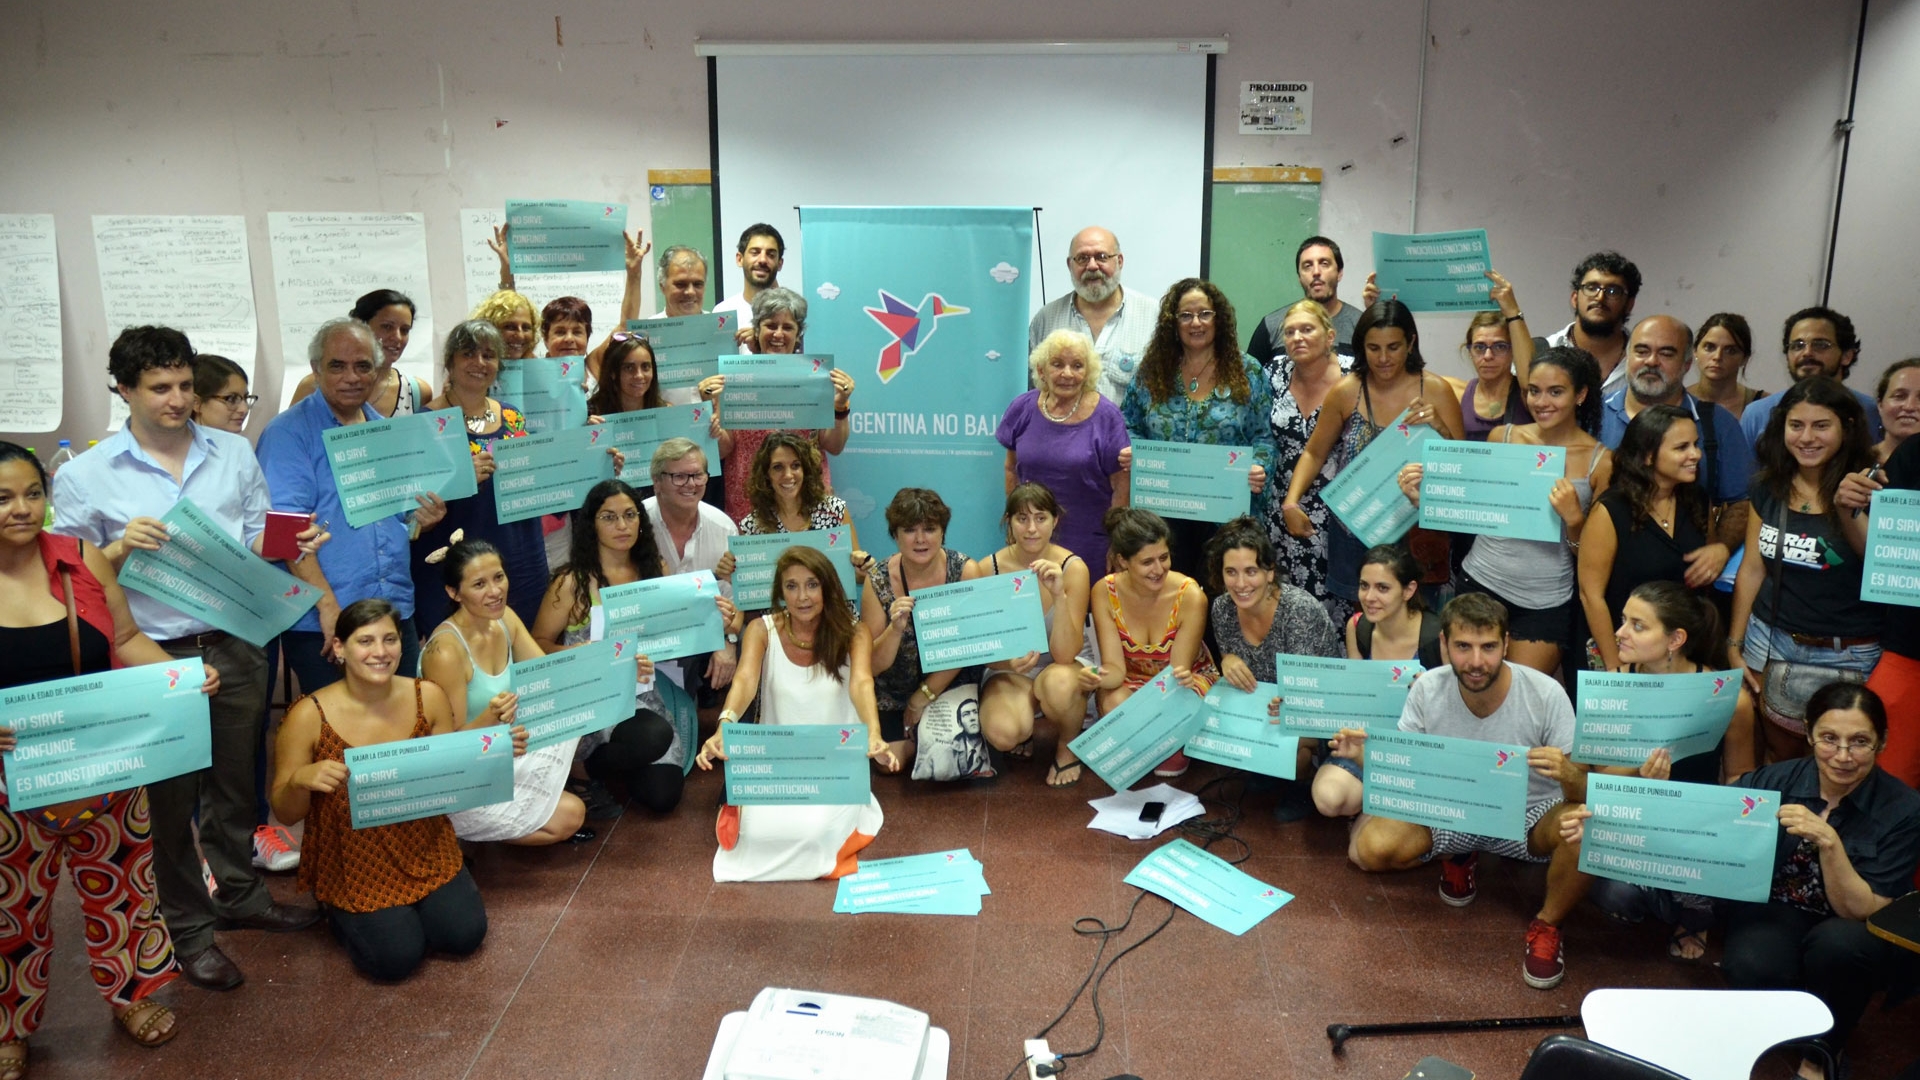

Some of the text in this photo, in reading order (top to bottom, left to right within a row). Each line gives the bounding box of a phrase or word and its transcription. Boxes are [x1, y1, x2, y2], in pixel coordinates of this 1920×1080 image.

[512, 216, 542, 224] NO SIRVE
[513, 234, 547, 243] CONFUNDE
[1405, 241, 1482, 255] ES INCONSTITUCIONAL
[514, 253, 585, 262] ES INCONSTITUCIONAL
[1448, 262, 1485, 274] CONFUNDE
[1456, 284, 1476, 293] SIRVE
[724, 392, 757, 401] CONFUNDE
[734, 410, 794, 419] INCONSTITUCIONAL
[852, 412, 996, 437] GENTINA NO BAJ
[335, 447, 367, 462] NO SIRVE
[499, 456, 530, 469] NO SIRVE
[1136, 459, 1166, 470] NO SIRVE
[1427, 462, 1461, 474] NO SIRVE
[340, 468, 376, 485] CONFUNDE
[501, 476, 535, 490] CONFUNDE
[1136, 478, 1169, 488] CONFUNDE
[346, 482, 423, 508] ES INCONSTITUCIONAL
[1426, 485, 1465, 497] CONFUNDE
[501, 489, 575, 511] ES INCONSTITUCIONAL
[1135, 495, 1206, 510] ES INCONSTITUCIONAL
[1425, 507, 1509, 524] ES INCONSTITUCIONAL
[1878, 517, 1894, 530] NO
[747, 552, 766, 561] SIRVE
[1759, 540, 1820, 563] RANDE
[1874, 544, 1920, 562] CONFUN
[737, 569, 772, 581] CONFUNDE
[1871, 572, 1885, 586] ES
[738, 591, 747, 599] ES
[609, 604, 640, 619] NO SIRVE
[918, 606, 951, 620] NO SIRVE
[922, 625, 959, 640] CONFUNDE
[925, 640, 1002, 660] ES INCONSTITUCIONAL
[517, 679, 550, 695] NO SIRVE
[1283, 676, 1318, 688] NO SIRVE
[5, 695, 25, 704] BAJAR
[37, 690, 53, 699] EDAD
[64, 681, 103, 695] PUNIBILIDAD
[517, 699, 555, 718] CONFUNDE
[1285, 697, 1324, 708] CONFUNDE
[1585, 699, 1628, 710] NO SIRVE
[9, 711, 64, 731] NO SIRVE
[1583, 723, 1632, 734] CONFUNDE
[14, 738, 76, 762] CONFUNDE
[730, 745, 766, 754] NO SIRVE
[1416, 740, 1444, 749] PUNIBILIDAD
[1580, 745, 1591, 754] ES
[352, 754, 368, 762] BAJAR
[399, 745, 430, 755] PUNIBILIDAD
[1371, 751, 1411, 766] NO SIRVE
[16, 756, 146, 792] ES INCONSTITUCIONAL
[732, 764, 773, 774] CONFUNDE
[355, 769, 398, 784] NO SIRVE
[1370, 773, 1416, 789] CONFUNDE
[357, 787, 405, 801] CONFUNDE
[733, 785, 819, 794] ES INCONSTITUCIONAL
[1596, 782, 1612, 791] BAJAR
[1623, 785, 1638, 794] EDAD
[1648, 787, 1682, 798] PUNIBILIDAD
[358, 796, 458, 819] ES INCONSTITUCIONAL
[1370, 794, 1466, 819] ES INCONSTITUCIONAL
[1595, 804, 1642, 820] NO SIRVE
[1591, 828, 1646, 847] CONFUNDE
[1587, 851, 1702, 879] ES INCONSTITUCIONAL
[815, 1029, 844, 1037] EPSON
